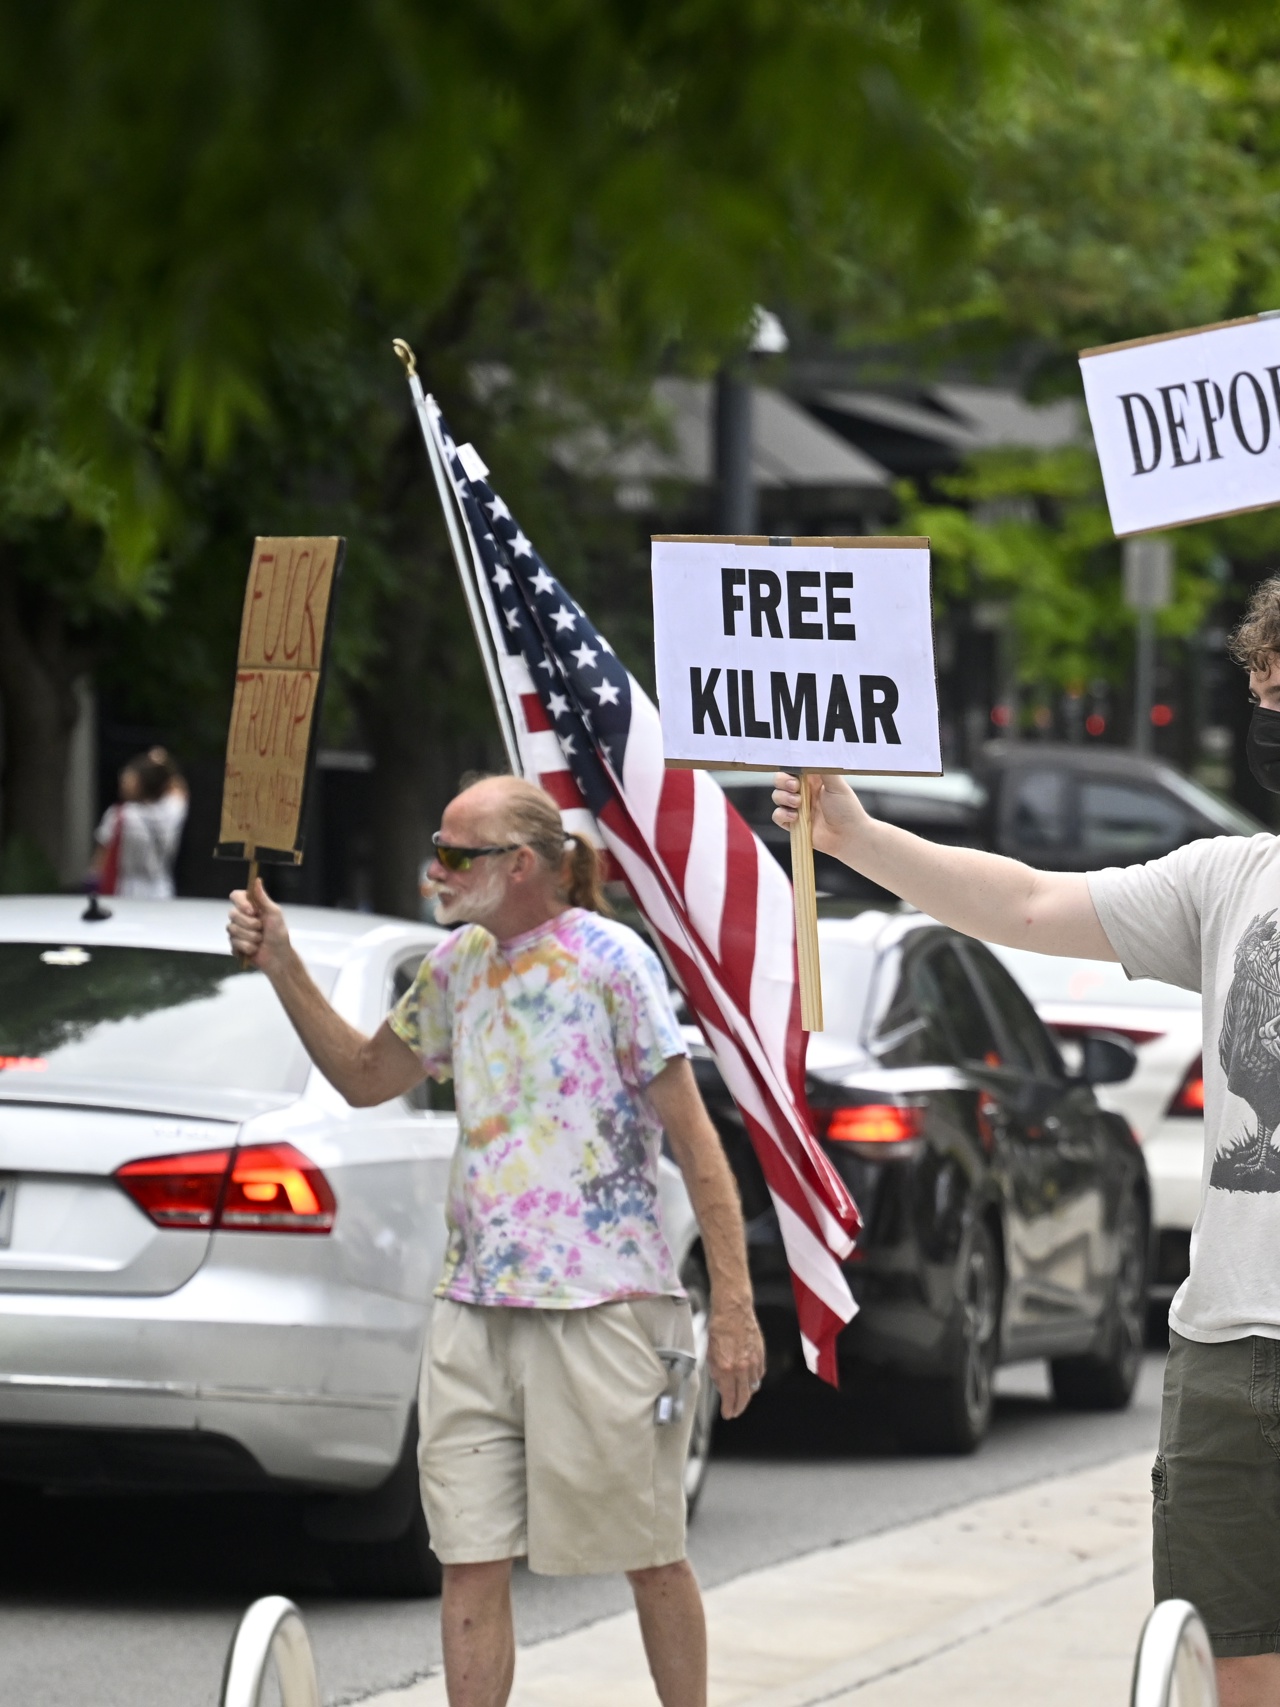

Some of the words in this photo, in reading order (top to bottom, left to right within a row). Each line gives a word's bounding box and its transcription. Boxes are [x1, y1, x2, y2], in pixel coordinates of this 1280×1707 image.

[245, 549, 327, 667] FUCK
[721, 568, 856, 640] FREE
[236, 671, 312, 758] TRUMP
[690, 667, 901, 744] KILMAR
